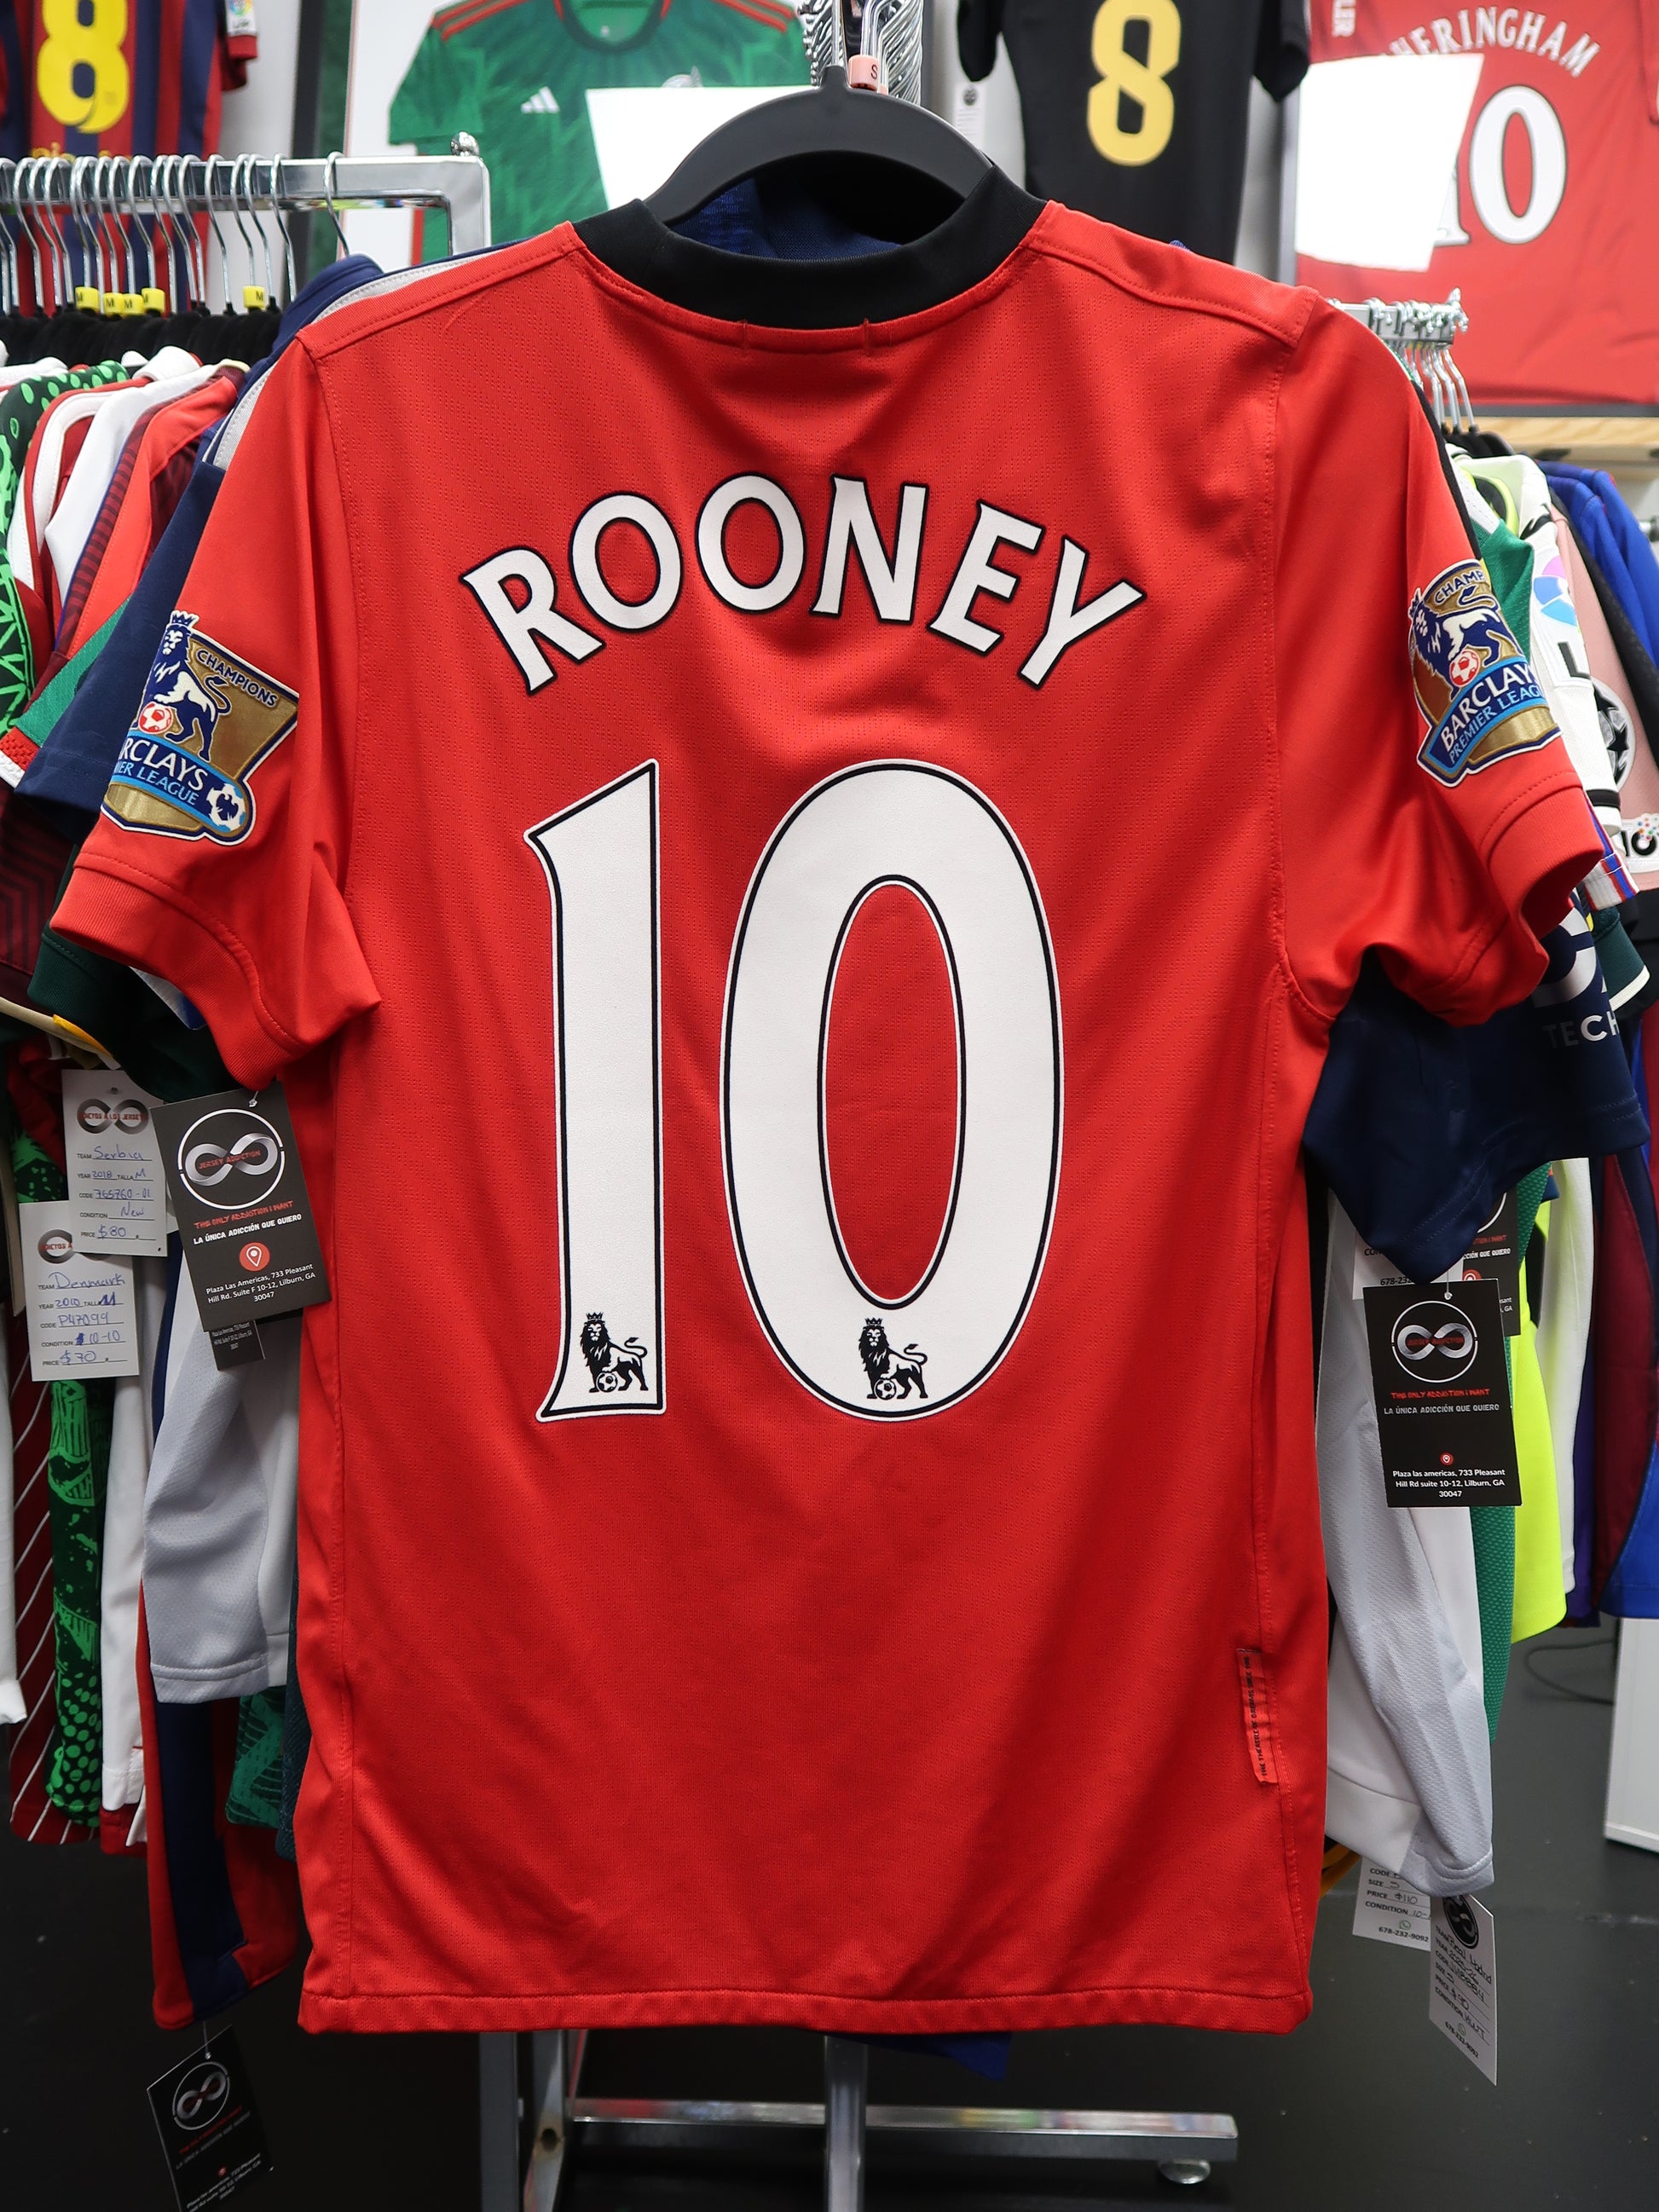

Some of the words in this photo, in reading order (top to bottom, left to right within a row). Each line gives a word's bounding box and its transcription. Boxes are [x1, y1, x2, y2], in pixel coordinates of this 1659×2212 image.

[1386, 6, 1601, 78] HERINGHAM
[870, 64, 878, 79] S
[1087, 0, 1182, 166] 8
[106, 298, 114, 308] M
[124, 299, 133, 309] M
[256, 291, 264, 301] M
[462, 472, 1147, 695] ROONEY
[1435, 570, 1484, 604] CHAMP
[197, 649, 278, 707] CHAMPIONS
[1441, 663, 1535, 752] BARCLAY
[1449, 706, 1497, 764] PREMIER
[1497, 684, 1542, 709] LEAG
[118, 737, 208, 791] RCLAYS
[136, 766, 199, 806] LEAGUE
[523, 758, 1065, 1422] 10
[199, 1158, 224, 1170] JERSEY
[92, 1170, 113, 1179] 2018
[120, 1201, 144, 1217] New
[205, 1232, 227, 1242] ÚNICA
[228, 1223, 260, 1238] ADICCIÓN
[261, 1219, 275, 1229] QUE
[277, 1213, 303, 1225] QUIERO
[48, 1271, 125, 1290] Denmark
[205, 1285, 224, 1295] Plaza
[237, 1276, 270, 1287] Americas,
[270, 1270, 284, 1279] 733
[285, 1263, 314, 1275] Pleasant
[208, 1295, 220, 1304] Hill
[220, 1292, 233, 1301] Rd.
[233, 1288, 251, 1298] Suite
[257, 1282, 279, 1292] 10-12,
[279, 1276, 304, 1287] Lilburn,
[304, 1272, 316, 1280] GA
[253, 1291, 275, 1302] 30047
[1396, 1406, 1418, 1414] ÚNICA
[1420, 1403, 1454, 1414] ADICCIÓN
[1472, 1403, 1500, 1412] QUIERO
[1392, 1470, 1412, 1478] Plaza
[1367, 1879, 1384, 1887] SIZE
[1367, 1890, 1388, 1899] PRICE
[1365, 1901, 1409, 1915] CONDITION
